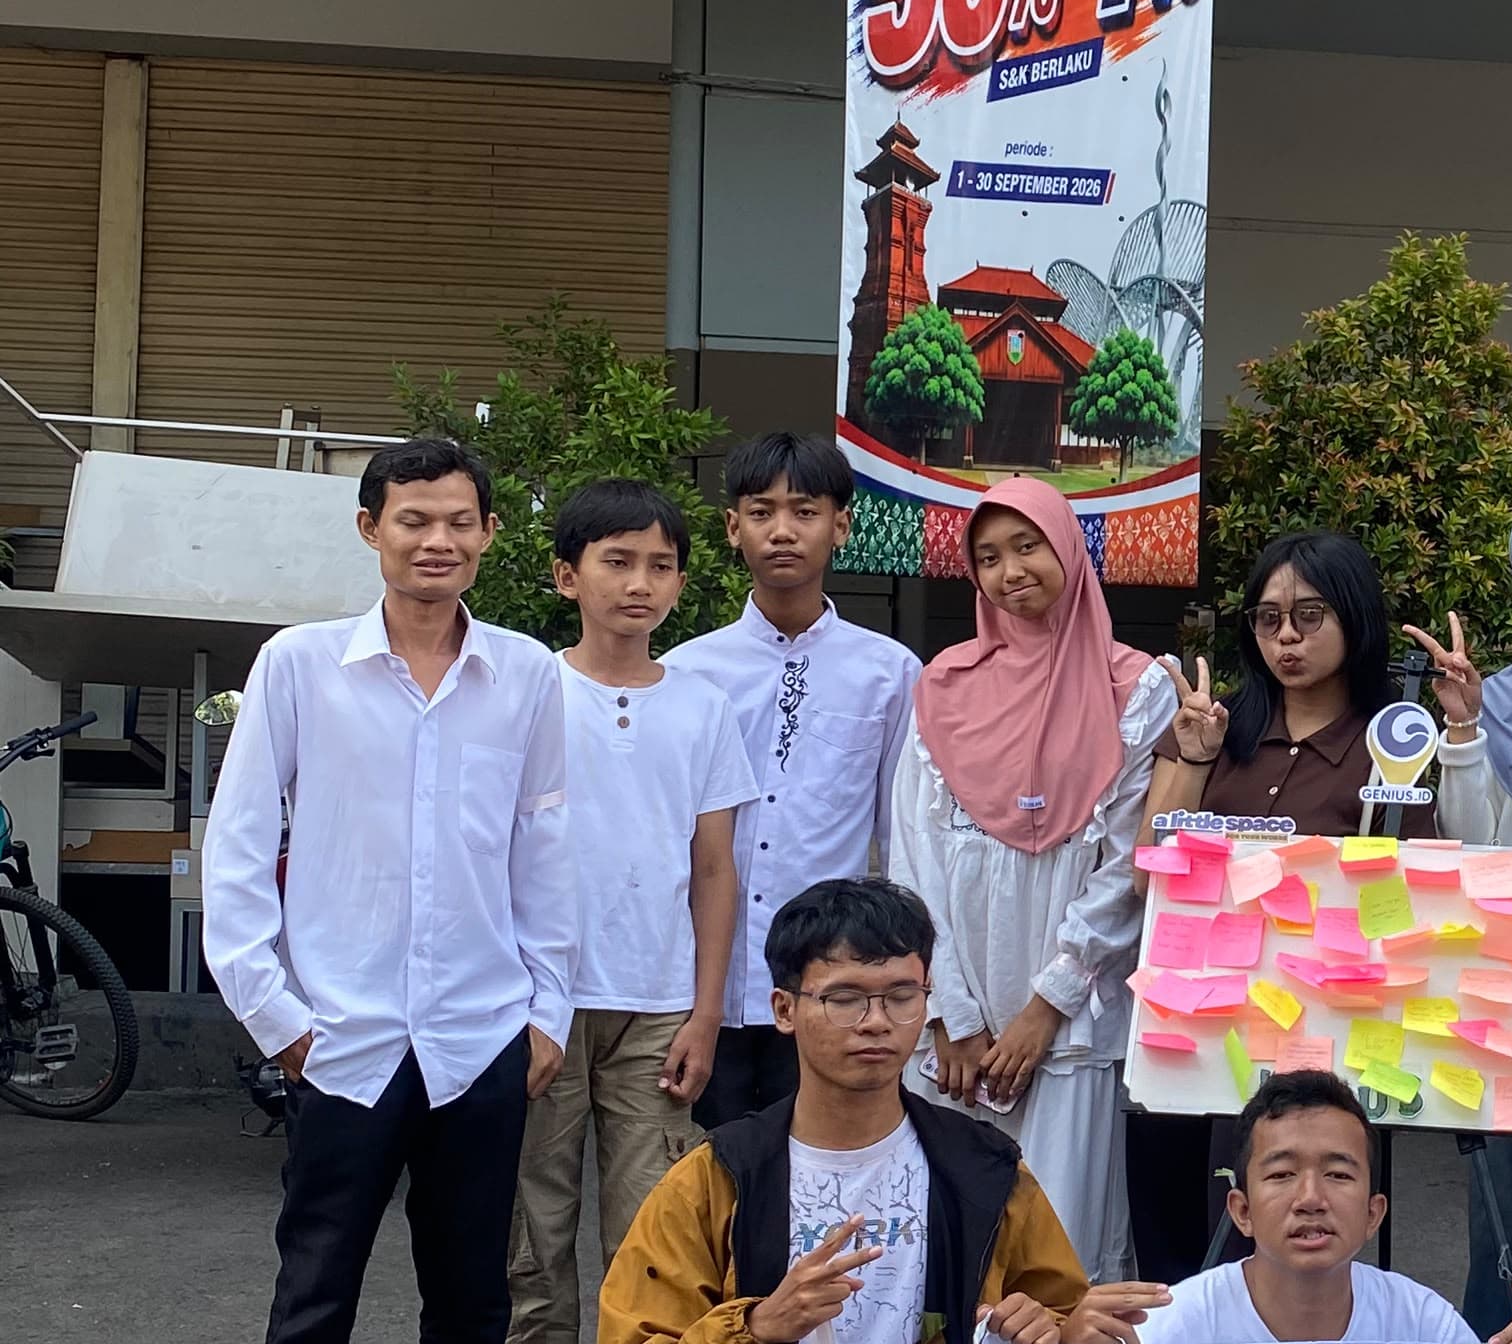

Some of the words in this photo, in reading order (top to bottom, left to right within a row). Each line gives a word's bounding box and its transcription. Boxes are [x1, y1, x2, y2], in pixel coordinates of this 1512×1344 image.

[999, 64, 1029, 90] S&K
[1030, 48, 1093, 83] BERLAKU
[957, 169, 965, 190] 1
[976, 171, 993, 191] 30
[994, 173, 1068, 196] SEPTEMBER
[1070, 177, 1101, 197] 2026
[1362, 788, 1431, 802] GENIUS.ID
[1153, 815, 1168, 828] a
[1169, 810, 1224, 830] little
[1225, 816, 1294, 833] space
